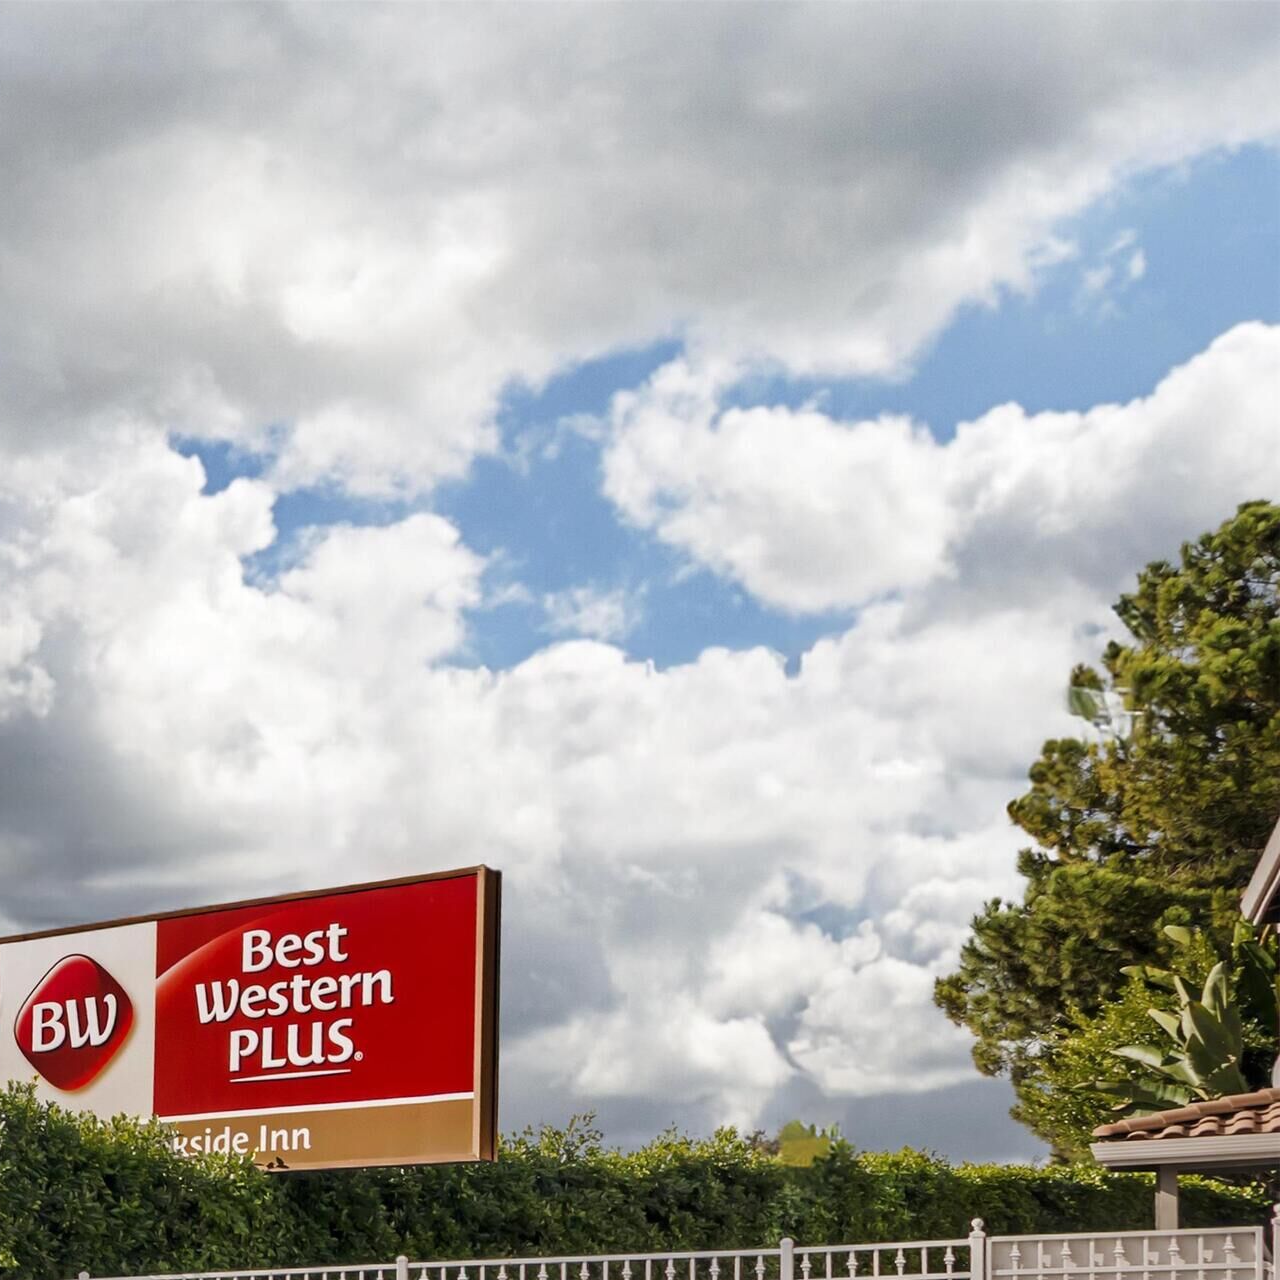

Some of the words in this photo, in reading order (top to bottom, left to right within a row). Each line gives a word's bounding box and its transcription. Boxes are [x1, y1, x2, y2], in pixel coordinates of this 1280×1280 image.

[242, 923, 348, 973] Best
[194, 970, 394, 1024] Western
[31, 995, 117, 1052] BW
[260, 1125, 311, 1152] Inn
